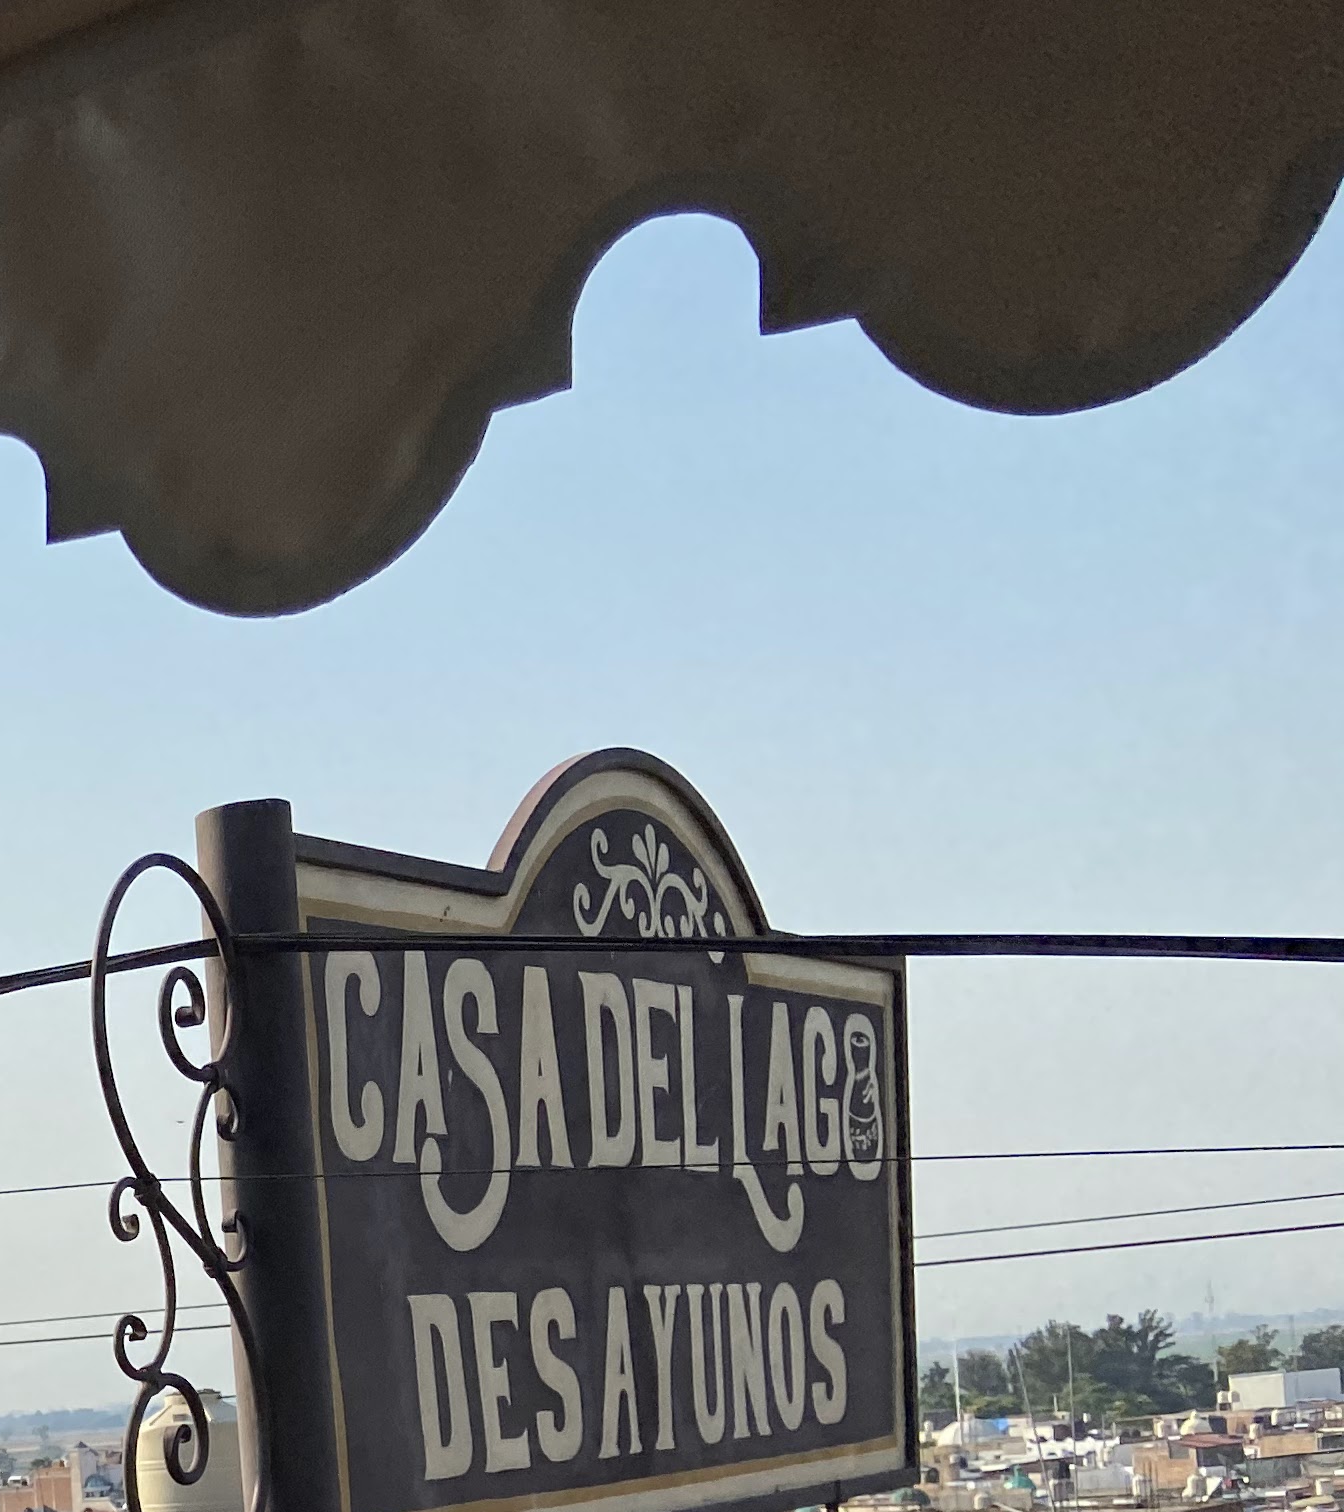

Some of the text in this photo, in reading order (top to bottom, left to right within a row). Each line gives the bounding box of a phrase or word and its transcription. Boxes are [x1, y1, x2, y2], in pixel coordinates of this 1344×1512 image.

[324, 948, 574, 1253] CASA
[579, 970, 721, 1173] DEL
[407, 1278, 847, 1481] DESAYUNOS
